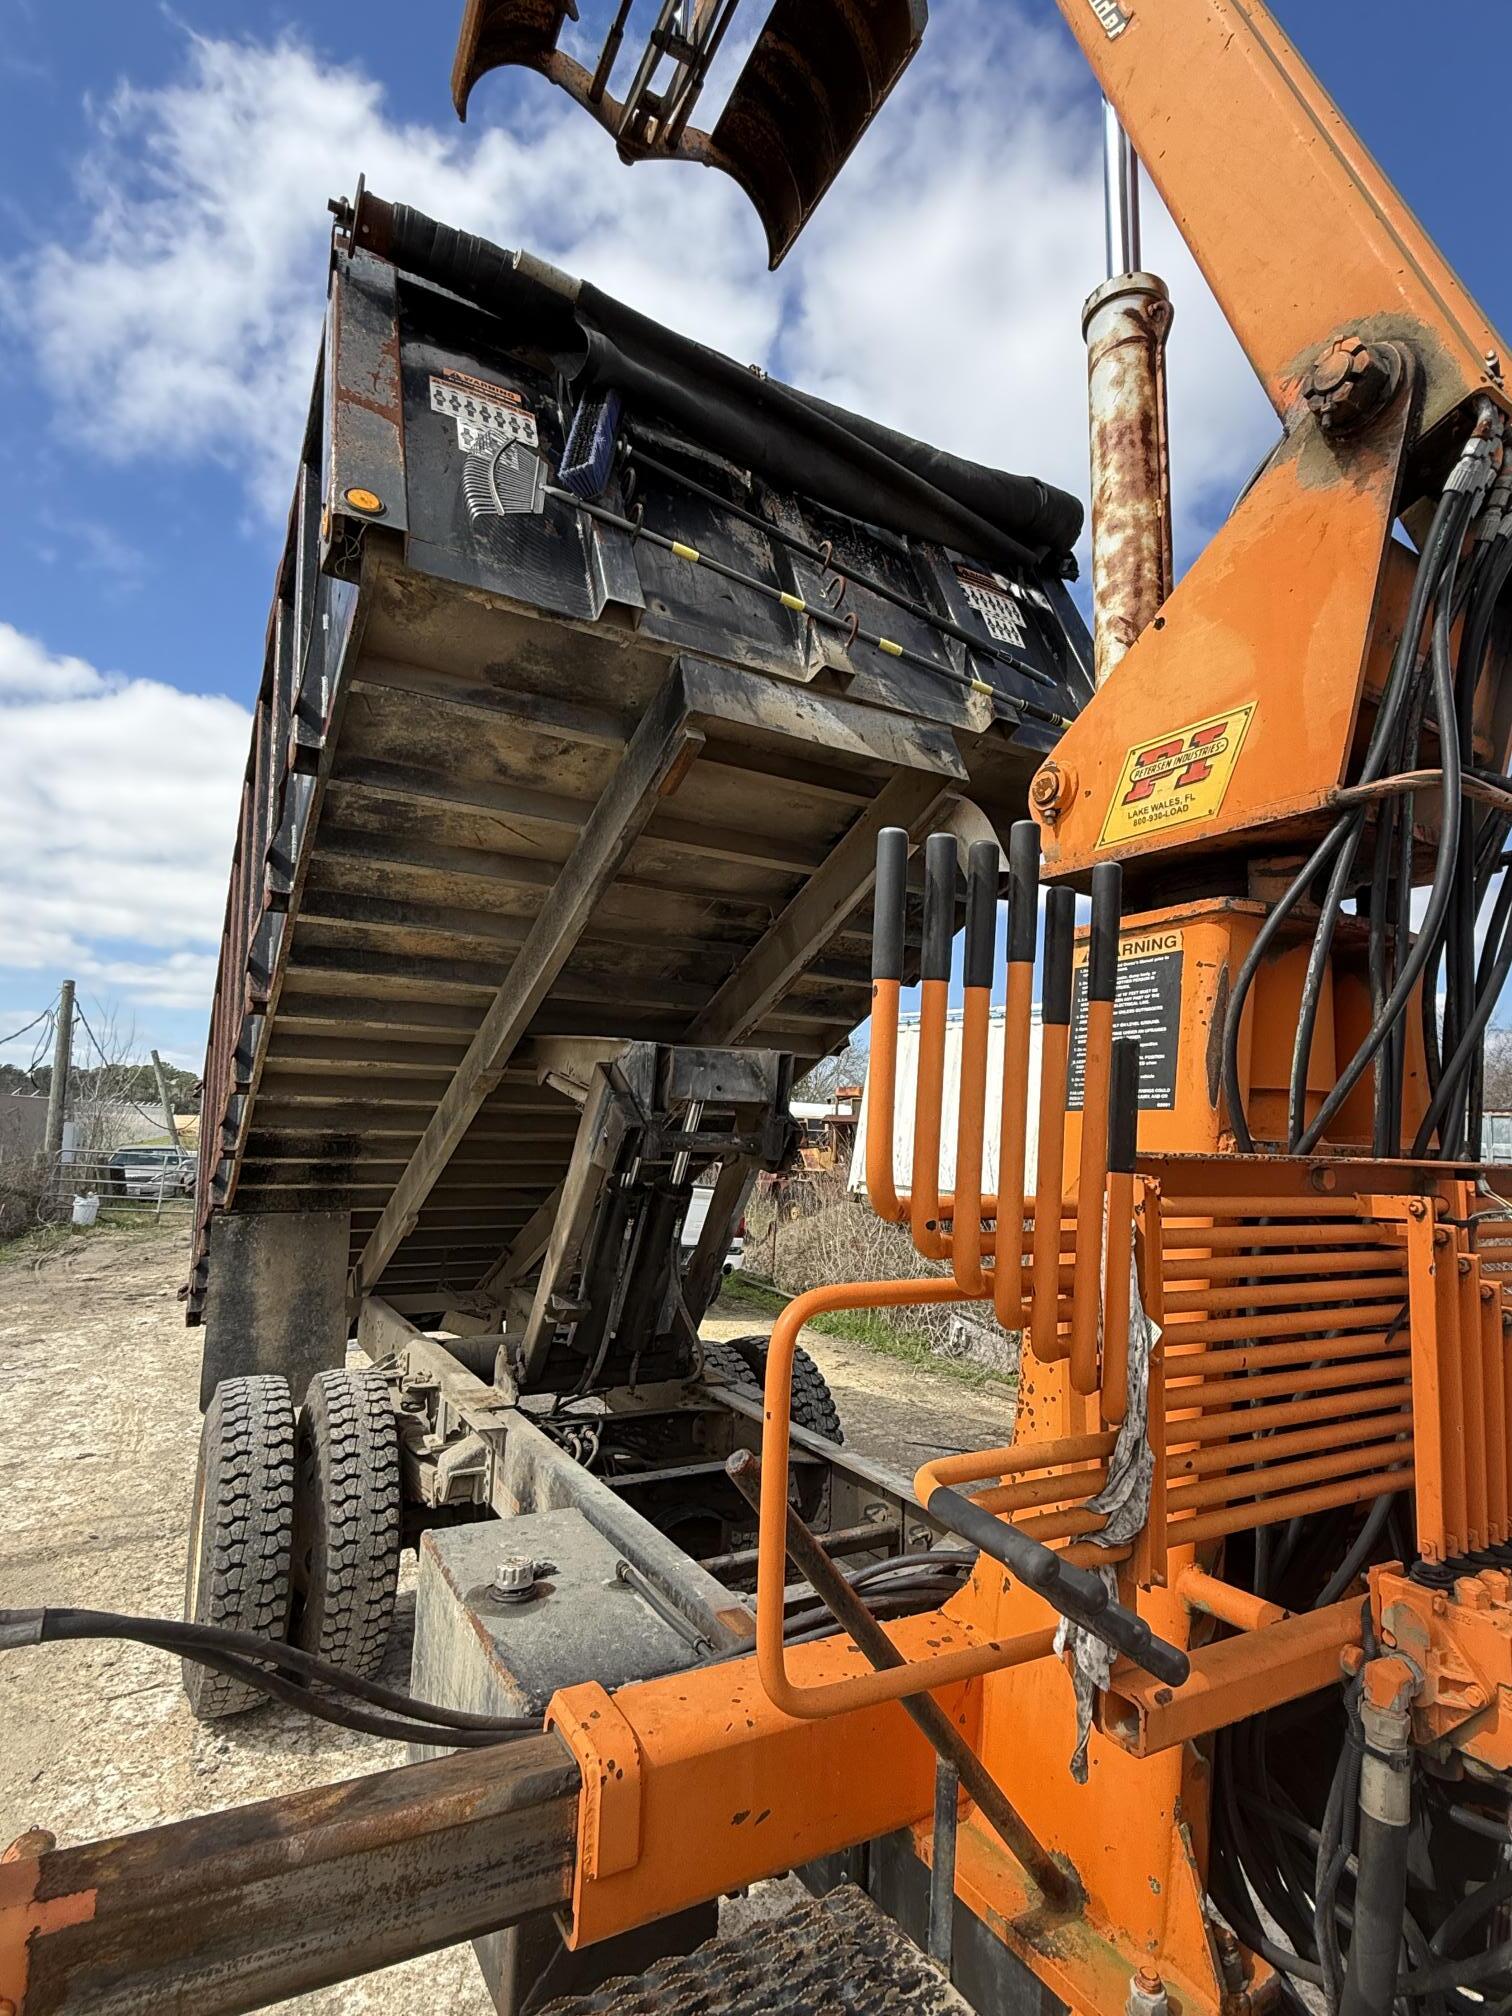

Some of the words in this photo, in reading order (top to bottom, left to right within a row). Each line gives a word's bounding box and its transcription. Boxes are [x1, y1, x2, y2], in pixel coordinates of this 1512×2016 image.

[1134, 760, 1172, 779] PETERSEN
[1127, 804, 1150, 819] LAKE
[1150, 797, 1183, 811] WALES,
[1185, 793, 1196, 803] FL
[1133, 804, 1190, 827] 800-930-LOAD
[1119, 935, 1177, 956] RNING
